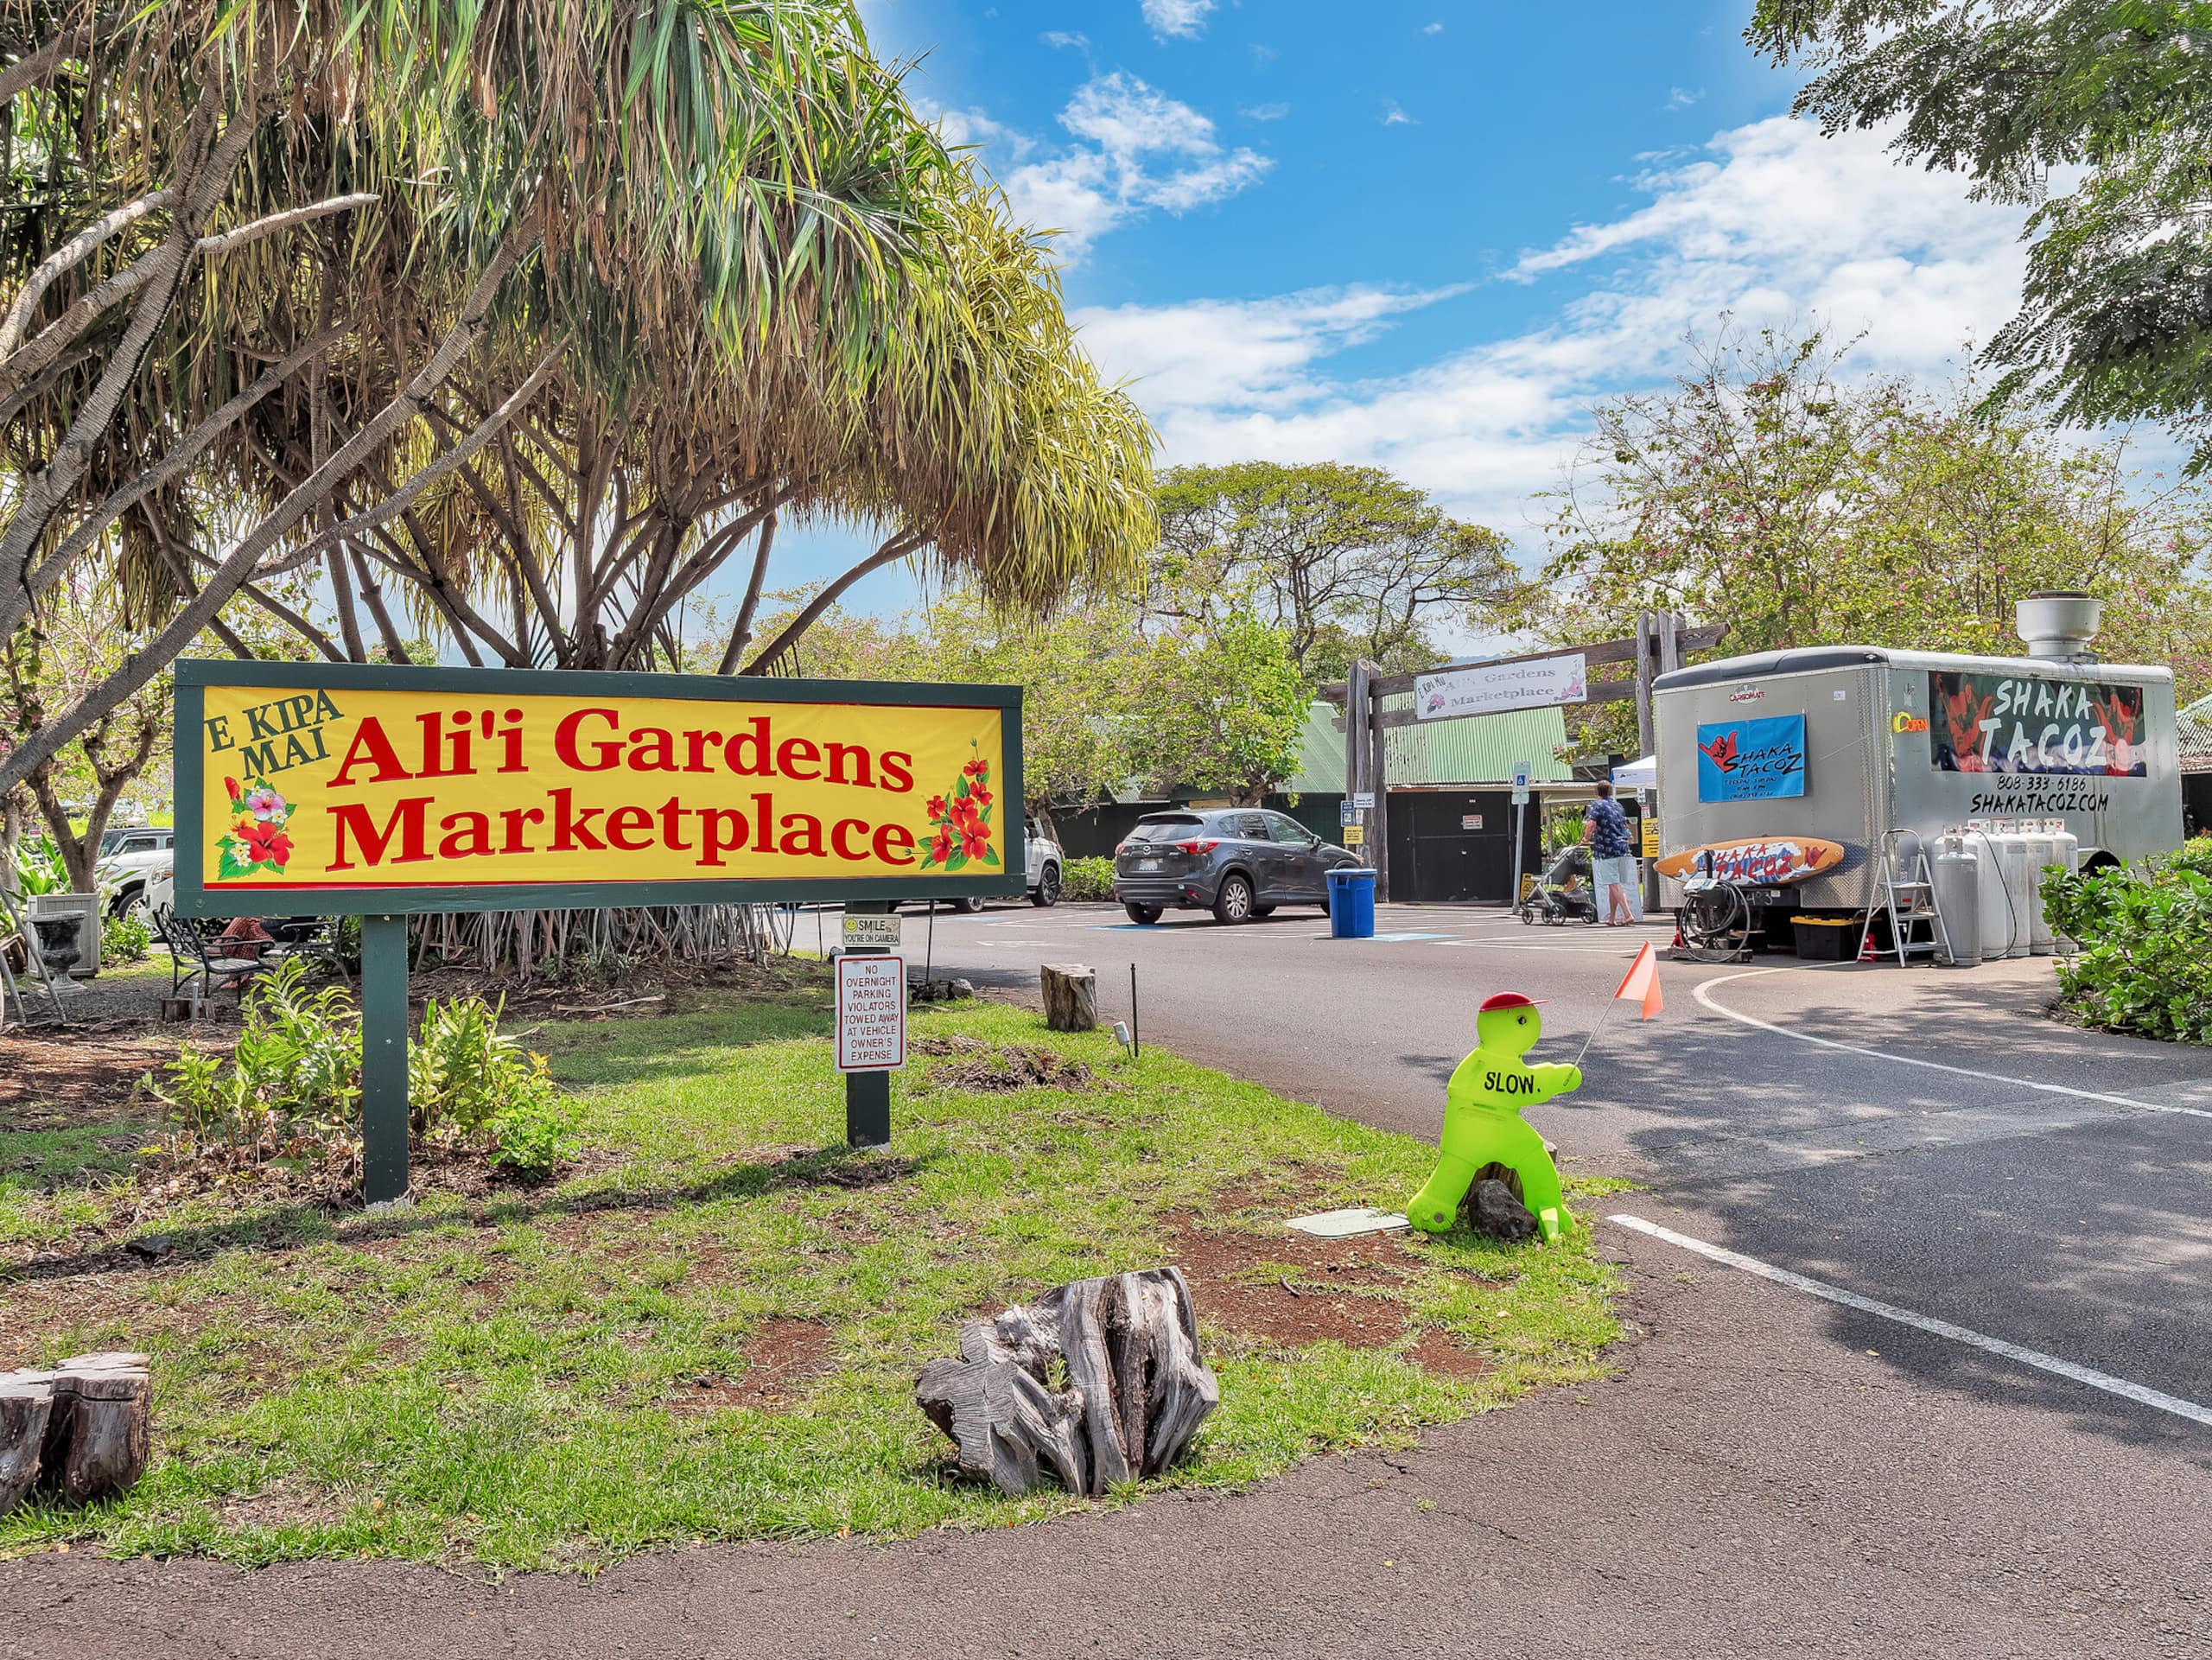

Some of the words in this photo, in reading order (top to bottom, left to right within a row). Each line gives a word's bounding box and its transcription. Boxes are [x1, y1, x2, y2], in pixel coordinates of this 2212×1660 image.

[1484, 669, 1555, 683] Gardens
[1451, 687, 1554, 707] Marketplace
[1993, 679, 2094, 720] SHAKA
[204, 715, 235, 753] E
[242, 689, 345, 742] KIPA
[1906, 718, 1929, 732] OPEN
[1979, 717, 2107, 768] TACOZ
[238, 726, 332, 781] MAI
[326, 709, 529, 788] Ali'i
[555, 708, 914, 793] Gardens
[1724, 743, 1793, 773] SHAKA
[1739, 753, 1803, 778] TACOZ
[325, 787, 916, 873] Marketplace
[1715, 855, 1794, 881] TACOZ
[859, 920, 885, 931] SMILE
[844, 934, 865, 943] YOU'RE
[874, 933, 899, 943] CAMERA
[865, 965, 878, 975] NO
[846, 976, 896, 988] OVERNIGHT
[853, 989, 891, 999] PARKING
[848, 1001, 896, 1012] VIOLATORS
[844, 1014, 876, 1025] TOWED
[878, 1013, 899, 1023] AWAY
[847, 1027, 857, 1036] AT
[860, 1025, 896, 1036] VEHICLE
[851, 1038, 893, 1049] OWNER'S
[851, 1050, 893, 1061] EXPENSE
[1484, 1072, 1541, 1095] SLOW.
